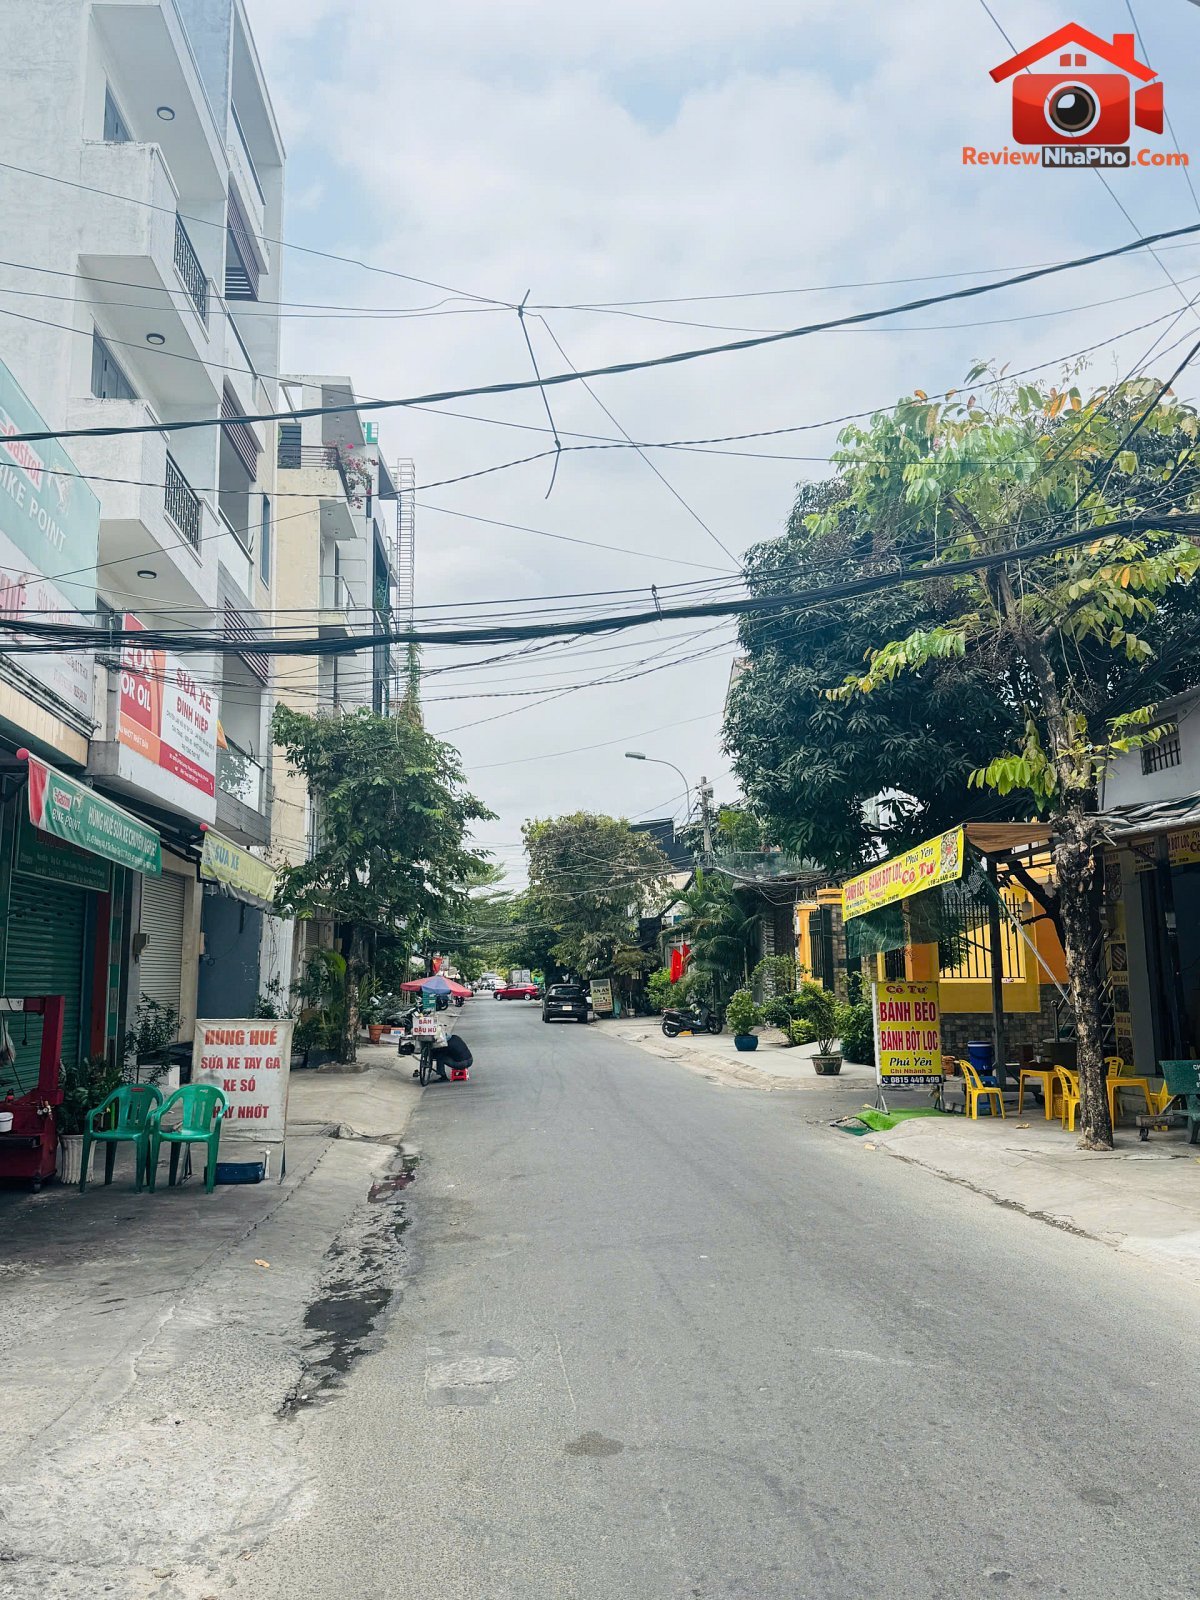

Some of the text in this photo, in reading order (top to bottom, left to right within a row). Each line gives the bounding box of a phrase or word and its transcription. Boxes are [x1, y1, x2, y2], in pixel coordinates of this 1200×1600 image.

[29, 497, 66, 552] POINT
[137, 685, 151, 712] OIL
[199, 688, 212, 714] XE
[65, 816, 81, 831] POINT
[906, 847, 933, 866] Phú Yên
[901, 860, 936, 885] Cô Tư
[886, 985, 928, 994] Cô Tư
[880, 998, 936, 1022] BÁNH BÈO
[250, 1025, 278, 1045] HUẾ
[881, 1026, 938, 1055] BÁNH BỘT LỌC
[201, 1054, 280, 1069] SỬA XE TAY GA
[890, 1057, 932, 1067] Phú Yên
[223, 1075, 256, 1092] XE SỐ
[212, 1103, 269, 1118] HAY NHỚT
